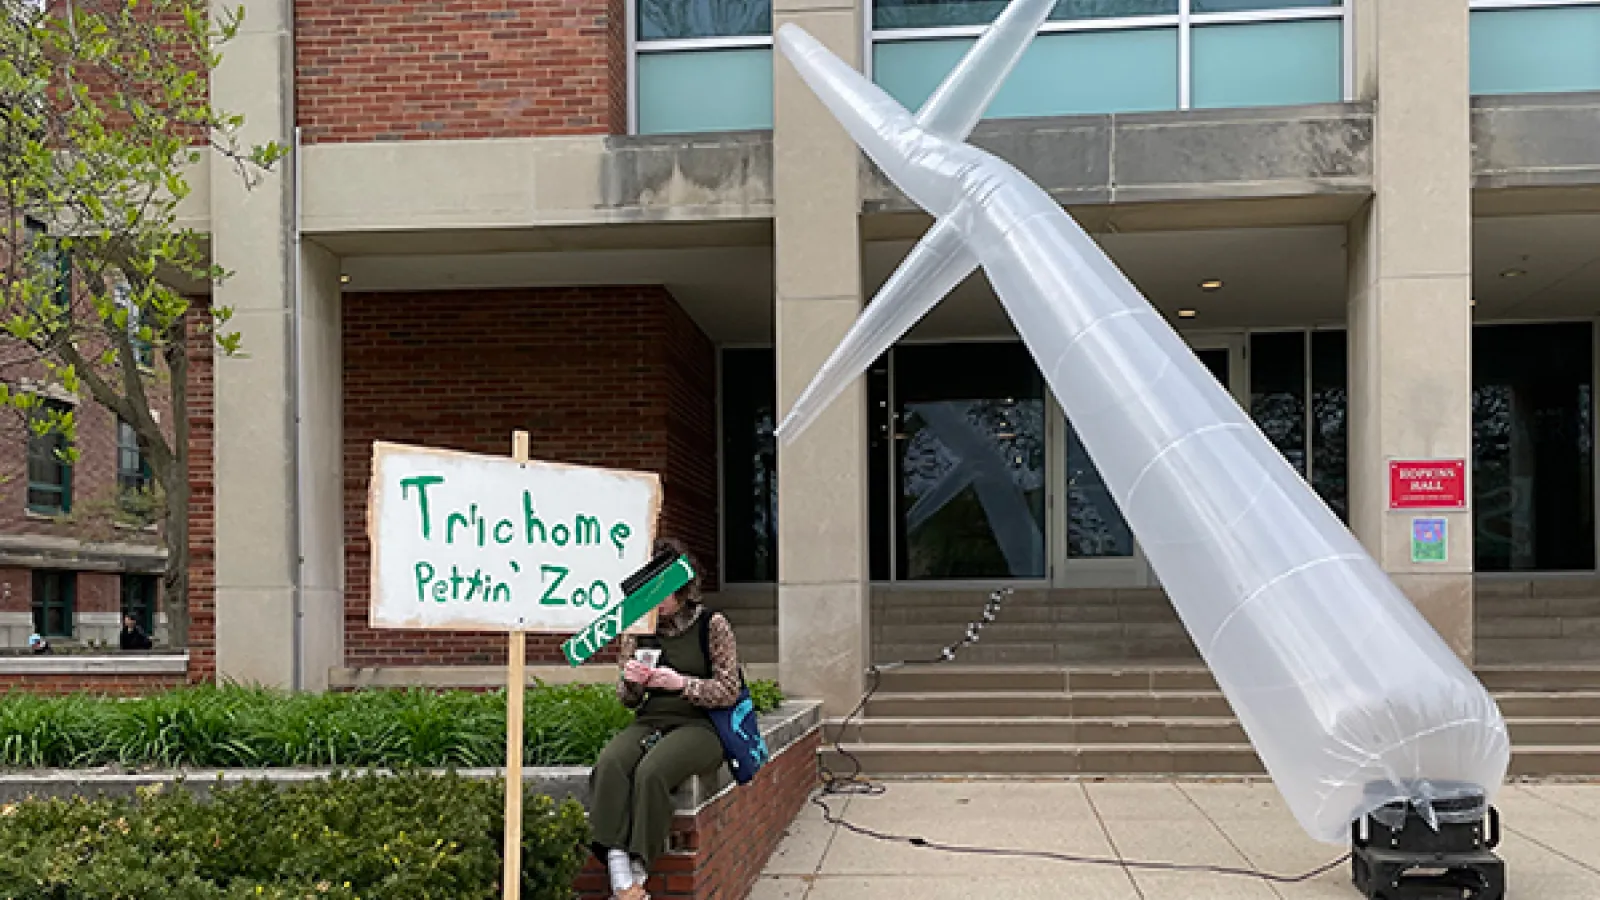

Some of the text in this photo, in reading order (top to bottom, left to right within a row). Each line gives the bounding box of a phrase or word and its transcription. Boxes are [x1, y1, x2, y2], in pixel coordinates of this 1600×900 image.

[1410, 480, 1444, 491] HALL
[400, 475, 632, 559] Trichome
[414, 561, 521, 602] Pettin'
